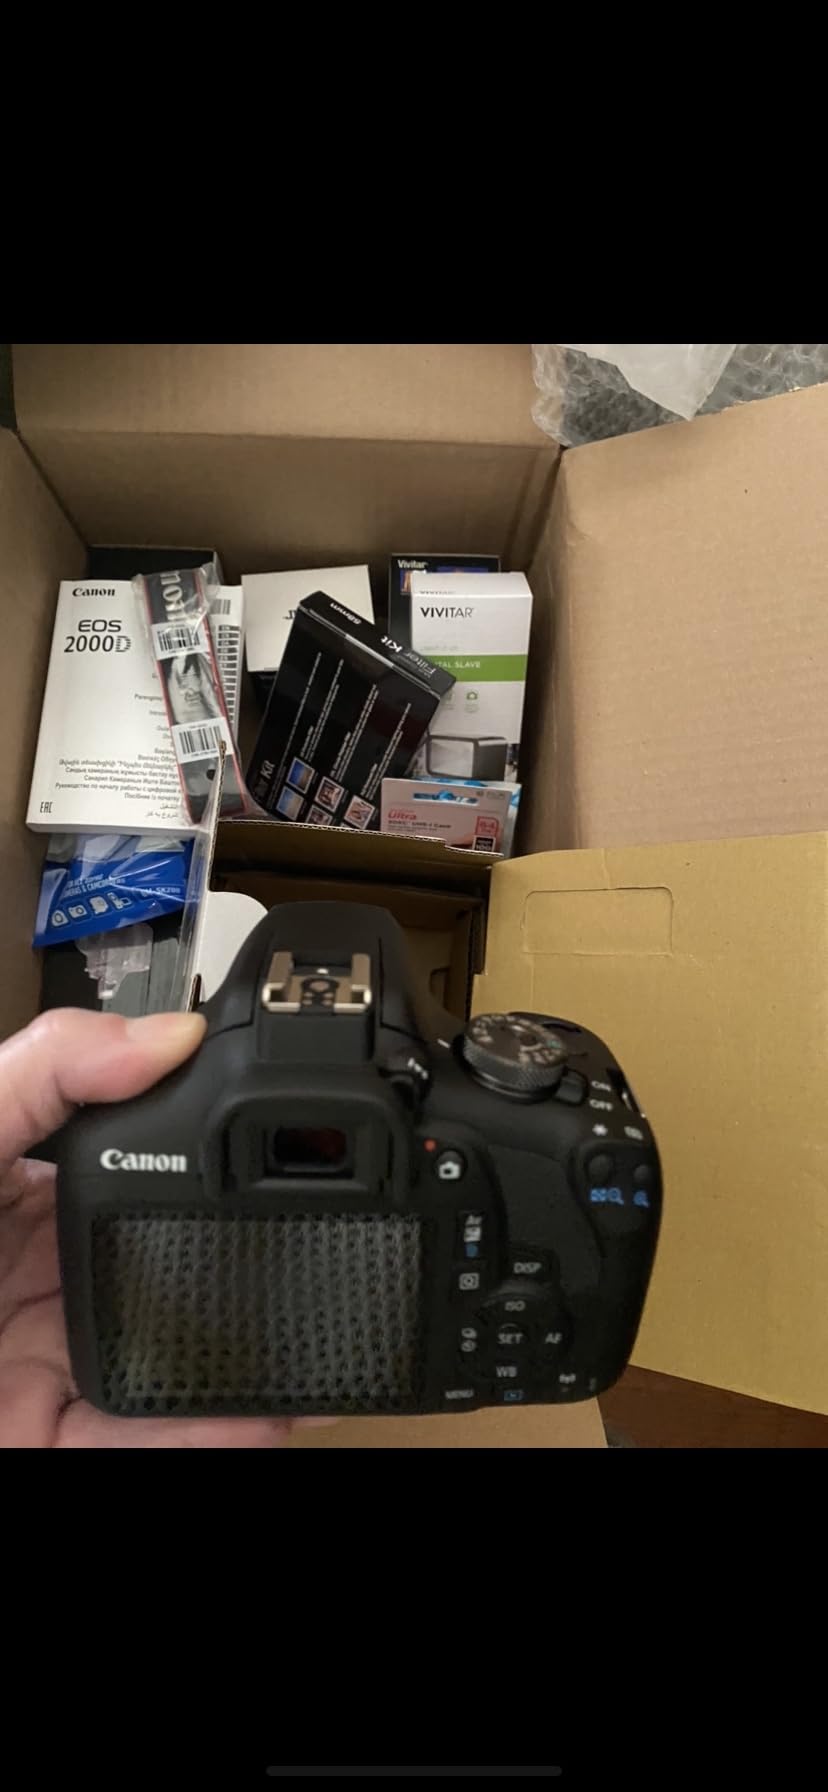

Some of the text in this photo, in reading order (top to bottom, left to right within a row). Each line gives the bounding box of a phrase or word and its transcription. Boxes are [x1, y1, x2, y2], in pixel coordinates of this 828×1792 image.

[398, 560, 425, 568] Vivitar
[72, 588, 116, 597] Canon
[420, 607, 474, 619] VIVITAR
[78, 619, 122, 632] EOS
[63, 635, 132, 653] 2000D
[380, 636, 403, 653] Kit
[454, 660, 481, 669] SLAVE
[260, 759, 277, 780] Kit
[388, 810, 417, 820] Ultra
[589, 1099, 614, 1111] OFF
[100, 1148, 187, 1172] Canon
[513, 1261, 542, 1274] DISP
[504, 1300, 526, 1312] ISO
[498, 1332, 524, 1345] SET
[545, 1332, 563, 1344] AF
[496, 1365, 518, 1378] WB
